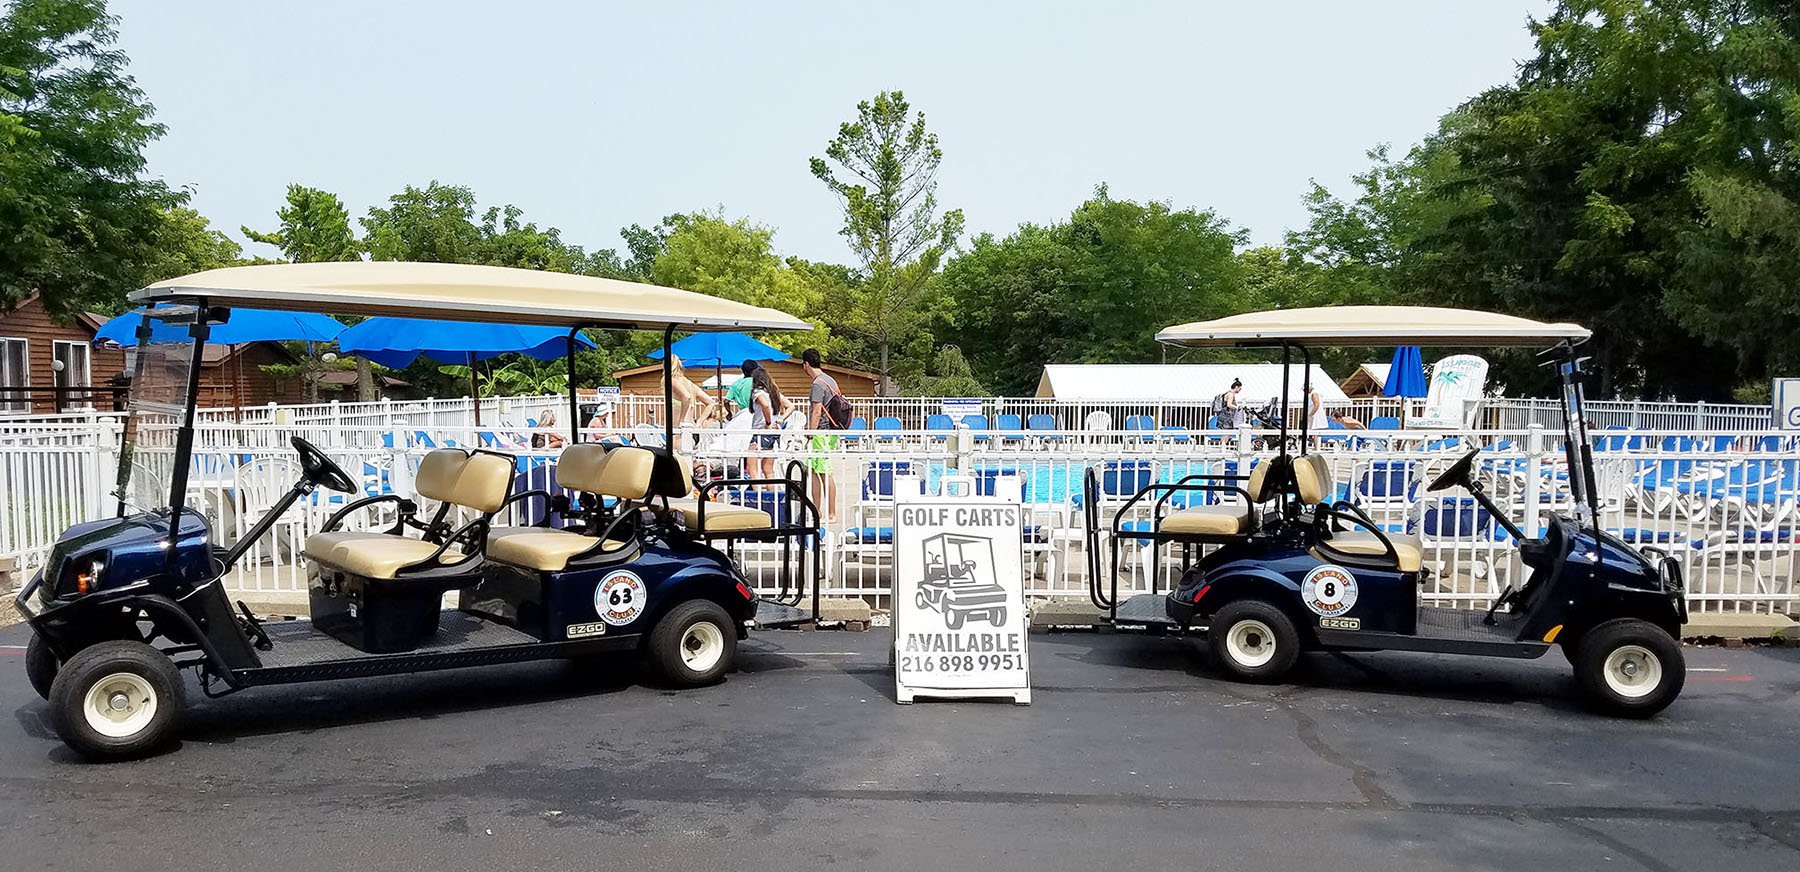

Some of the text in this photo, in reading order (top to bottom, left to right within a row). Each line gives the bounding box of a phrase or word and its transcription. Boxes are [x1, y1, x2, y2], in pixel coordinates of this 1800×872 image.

[902, 508, 1016, 526] GOLF CARTS
[603, 576, 639, 592] ISLAND
[1311, 570, 1350, 586] ISLAND
[609, 588, 632, 606] 63
[1324, 582, 1336, 597] 8
[607, 607, 635, 619] CLUB
[1314, 600, 1343, 611] CLUB
[905, 633, 1020, 652] AVAILABLE
[901, 654, 1024, 673] 216 898 9951
